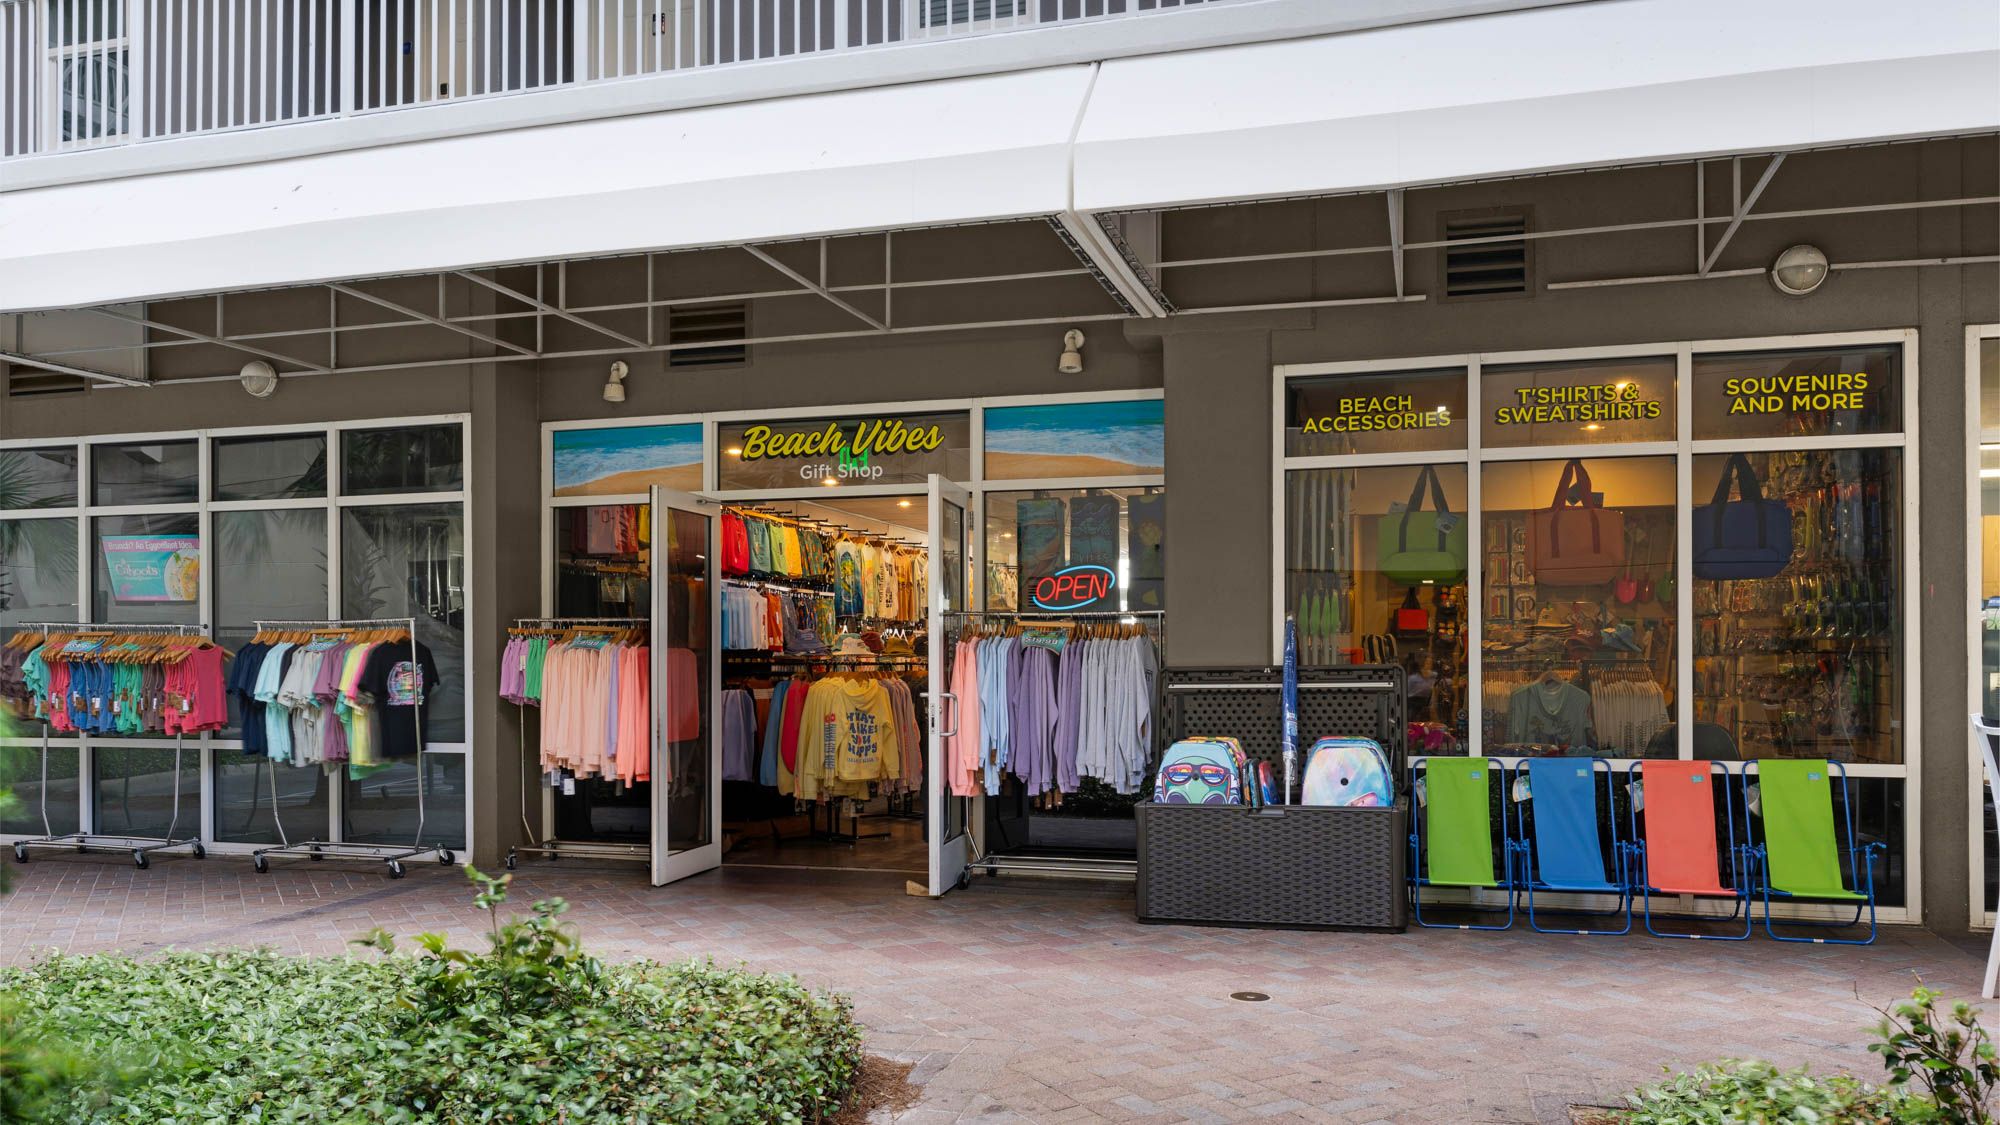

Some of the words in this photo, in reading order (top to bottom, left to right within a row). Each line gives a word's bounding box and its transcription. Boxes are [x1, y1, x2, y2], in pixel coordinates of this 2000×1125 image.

[1517, 384, 1616, 404] T'SHIRTS
[1624, 382, 1639, 400] &
[1726, 373, 1868, 395] SOUVENIRS
[1340, 395, 1412, 414] BEACH
[1497, 401, 1661, 424] SWEATSHIRTS
[1730, 396, 1784, 414] AND
[1792, 392, 1864, 412] MORE
[1303, 411, 1451, 433] ACCESSORIES
[743, 421, 846, 460] Beach
[851, 418, 945, 456] Vibes
[800, 464, 832, 480] Gift
[838, 463, 883, 480] Shop
[135, 541, 145, 550] An
[1036, 573, 1108, 601] OPEN
